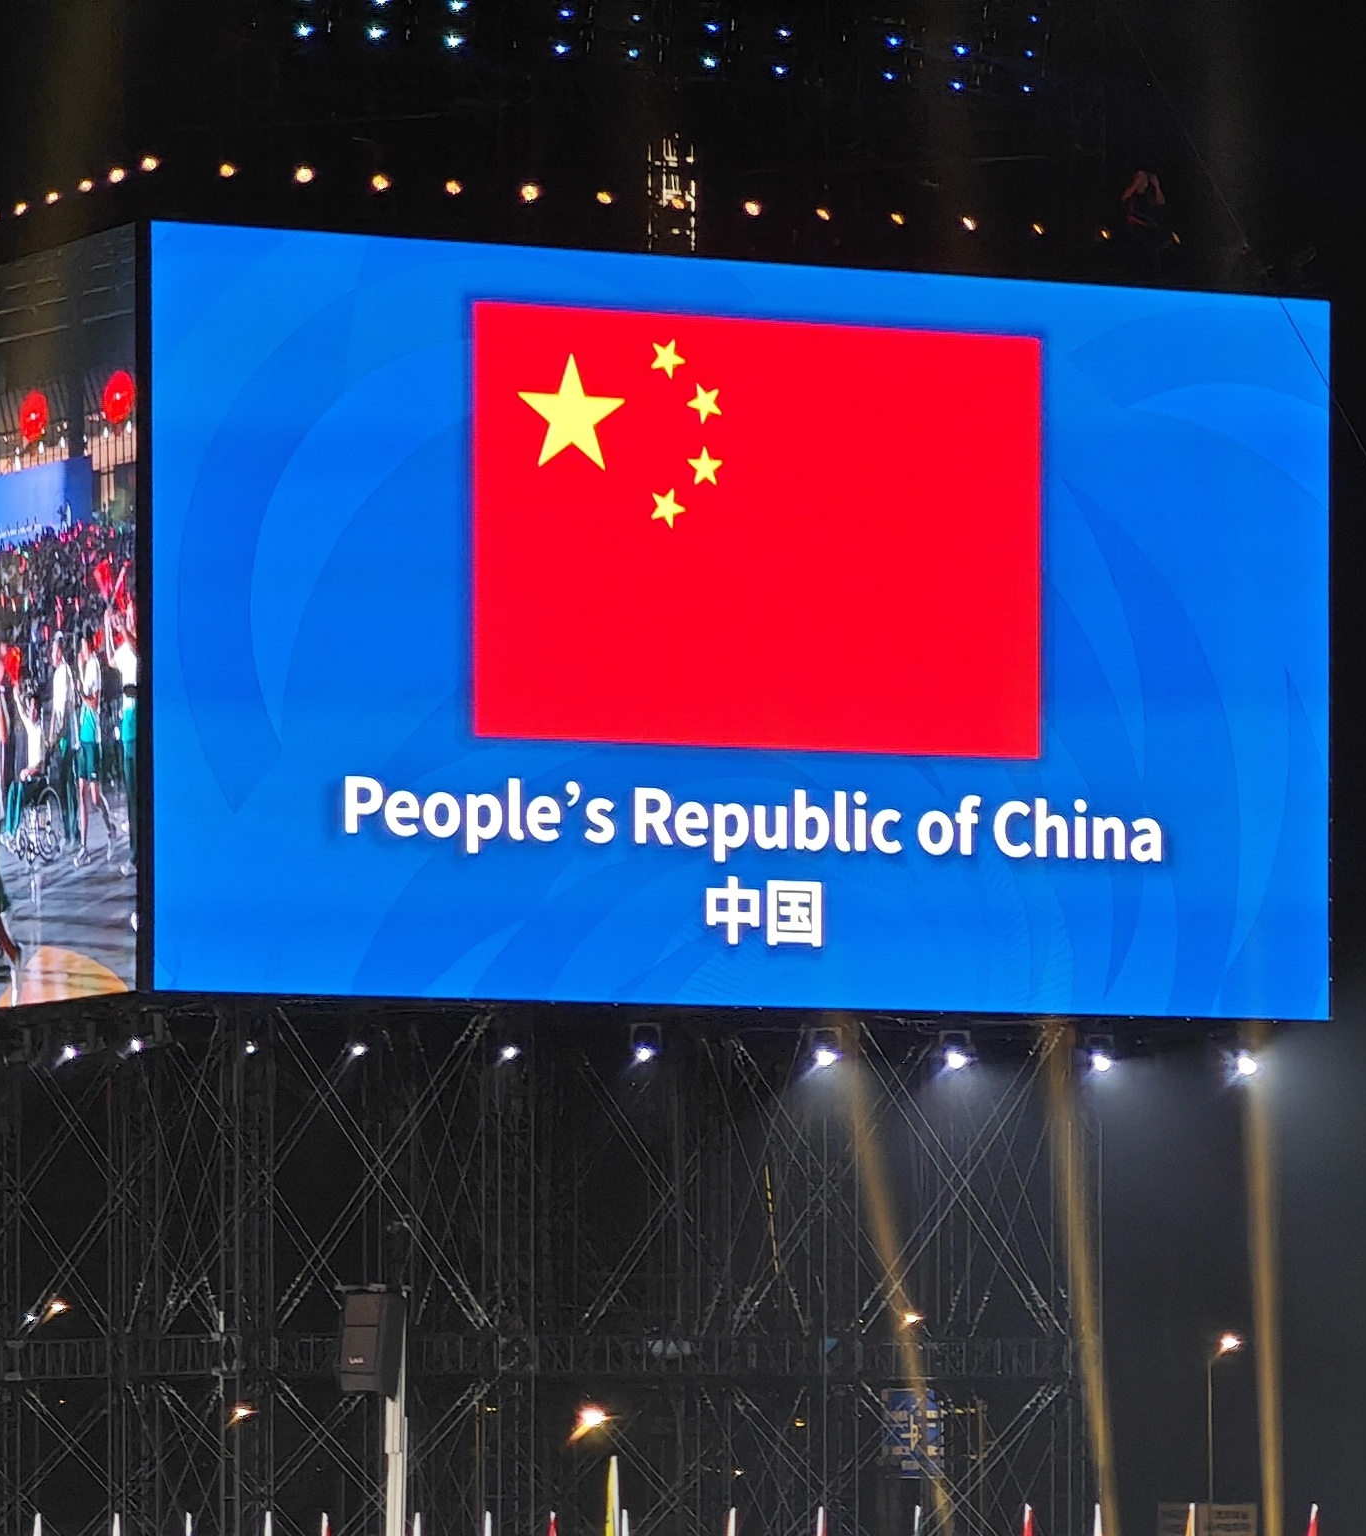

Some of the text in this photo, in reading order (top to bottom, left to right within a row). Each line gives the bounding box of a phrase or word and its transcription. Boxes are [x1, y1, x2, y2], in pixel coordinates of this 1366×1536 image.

[345, 776, 1161, 862] People’s Republic of China
[706, 876, 822, 947] 中国
